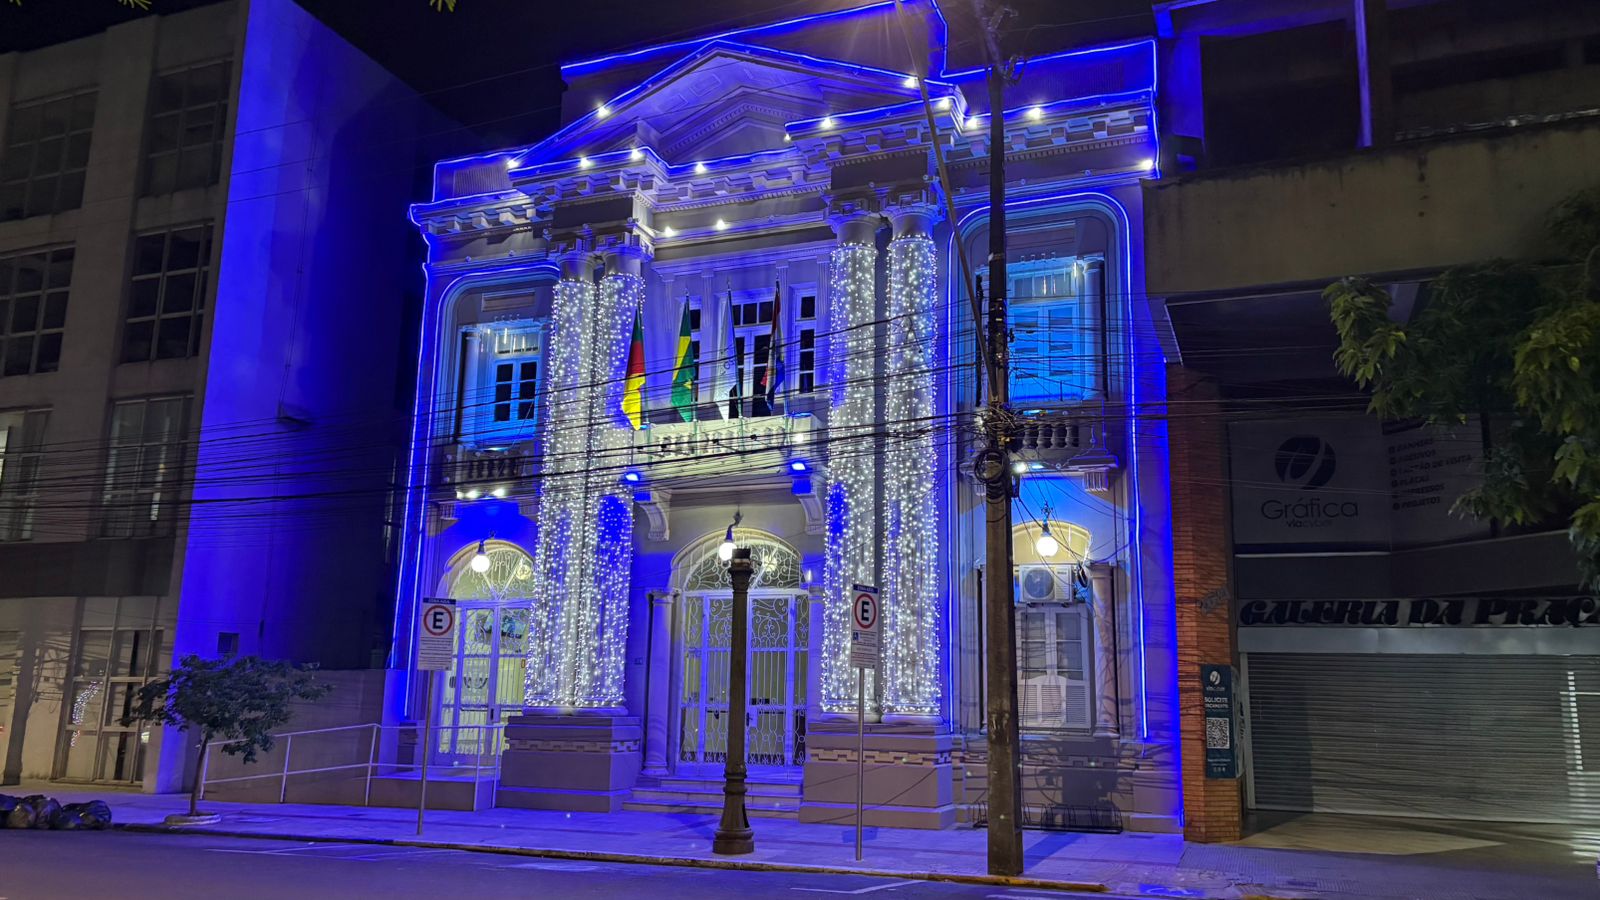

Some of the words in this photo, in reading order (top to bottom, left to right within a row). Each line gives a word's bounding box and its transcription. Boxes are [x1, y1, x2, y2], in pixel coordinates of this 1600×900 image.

[1261, 497, 1358, 520] Gráfica
[433, 611, 444, 629] E
[861, 600, 870, 621] E
[1240, 599, 1399, 625] GALERIA
[1408, 598, 1467, 626] DA
